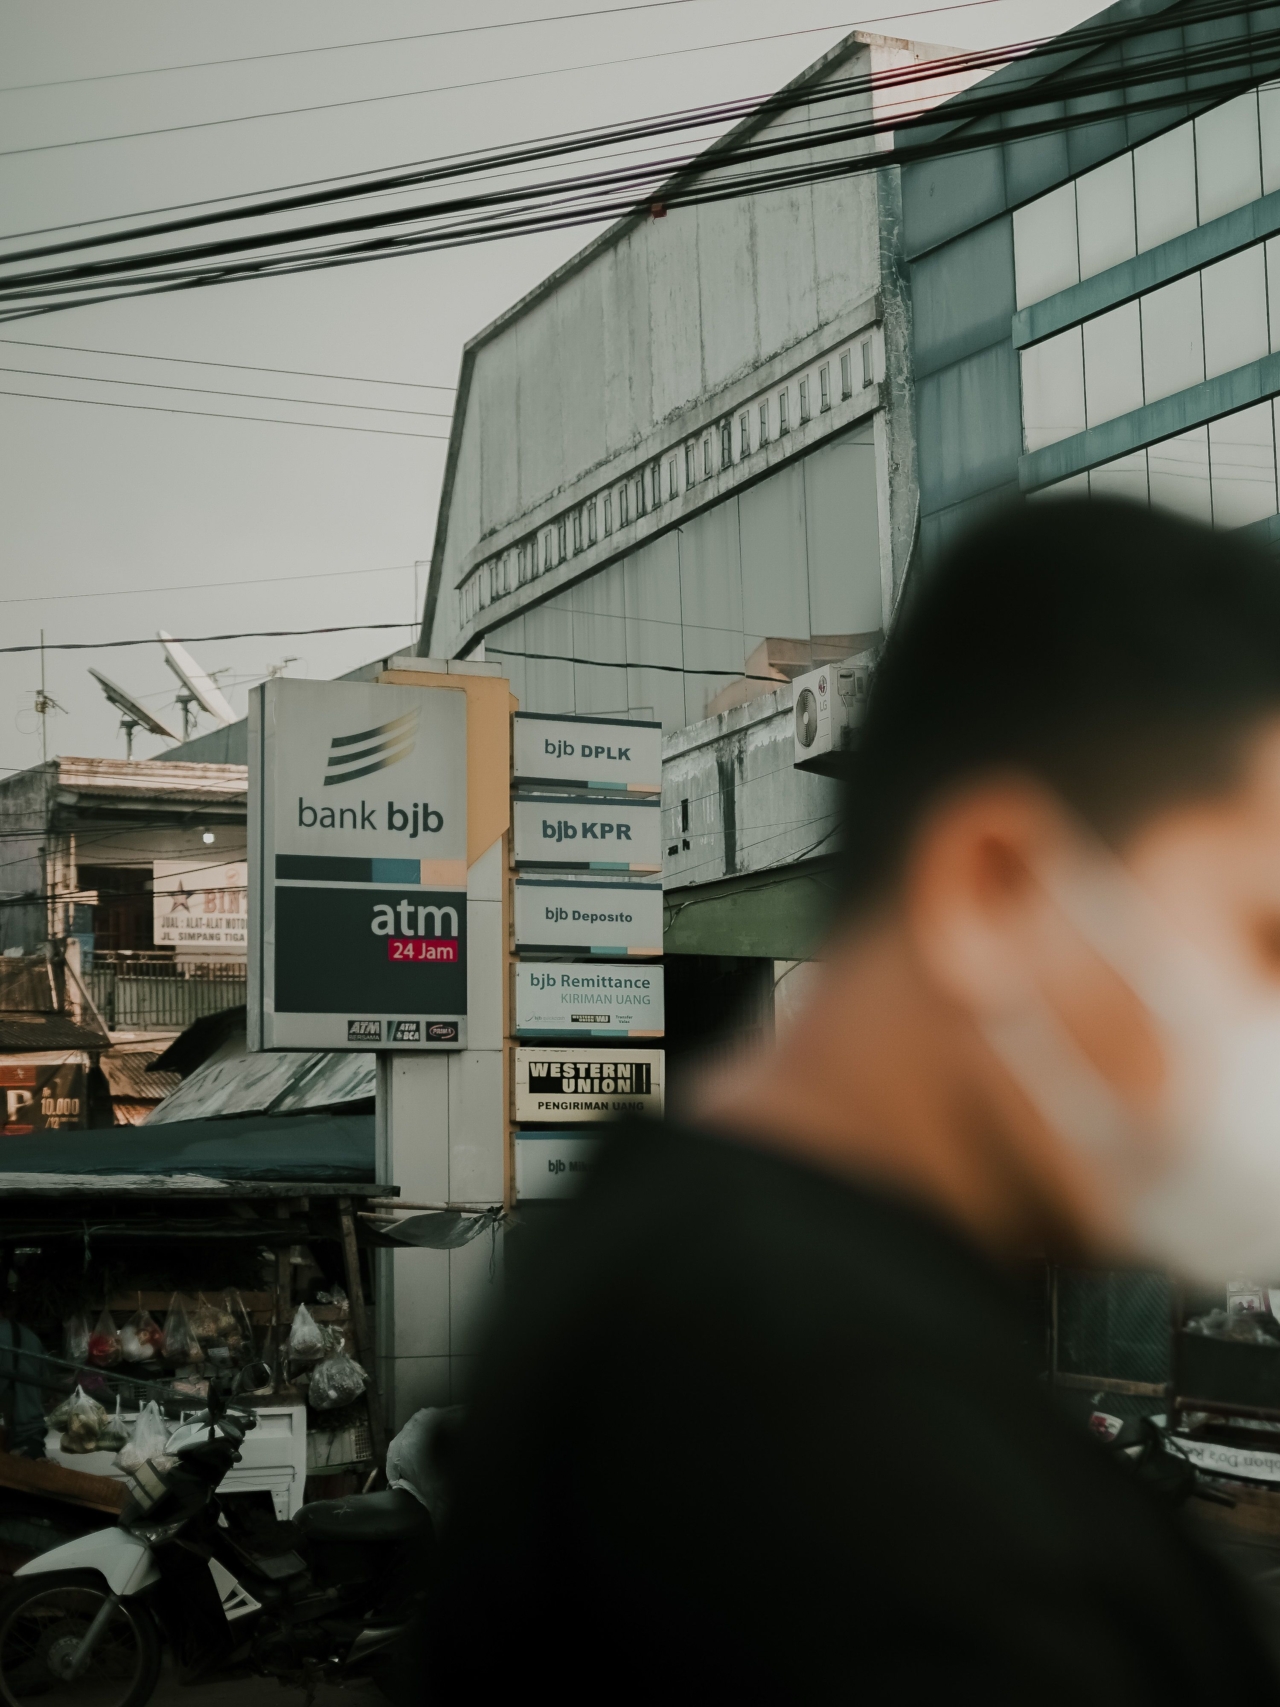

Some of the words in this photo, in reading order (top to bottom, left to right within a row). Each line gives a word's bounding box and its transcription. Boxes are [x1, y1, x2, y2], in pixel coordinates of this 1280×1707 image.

[544, 738, 575, 758] bjb
[581, 744, 631, 761] DPLK
[298, 796, 378, 831] bank
[387, 800, 444, 839] bjb
[541, 819, 577, 843] bjb
[581, 821, 632, 841] KPR
[203, 889, 247, 914] BIN
[161, 917, 179, 928] JUAL
[186, 917, 223, 929] ALAT-ALAT
[226, 918, 247, 929] MOTO
[371, 899, 459, 937] atm
[545, 907, 569, 923] bjb
[572, 910, 633, 924] Deposito
[178, 932, 221, 941] SIMPANG
[224, 933, 245, 942] TIGA
[393, 942, 414, 959] 24
[418, 943, 454, 960] Jam
[530, 973, 557, 990] bjb
[561, 974, 651, 989] Remittance
[561, 993, 613, 1006] KIRIMAN
[616, 994, 651, 1005] UANG
[349, 1022, 380, 1034] ATM
[403, 1032, 419, 1040] BCA
[530, 1062, 631, 1078] WESTERN
[562, 1078, 631, 1093] UNION
[41, 1098, 80, 1115] 10.000
[538, 1101, 609, 1110] PENGIRIMAN
[612, 1101, 644, 1111] UANG
[548, 1159, 566, 1175] bjb
